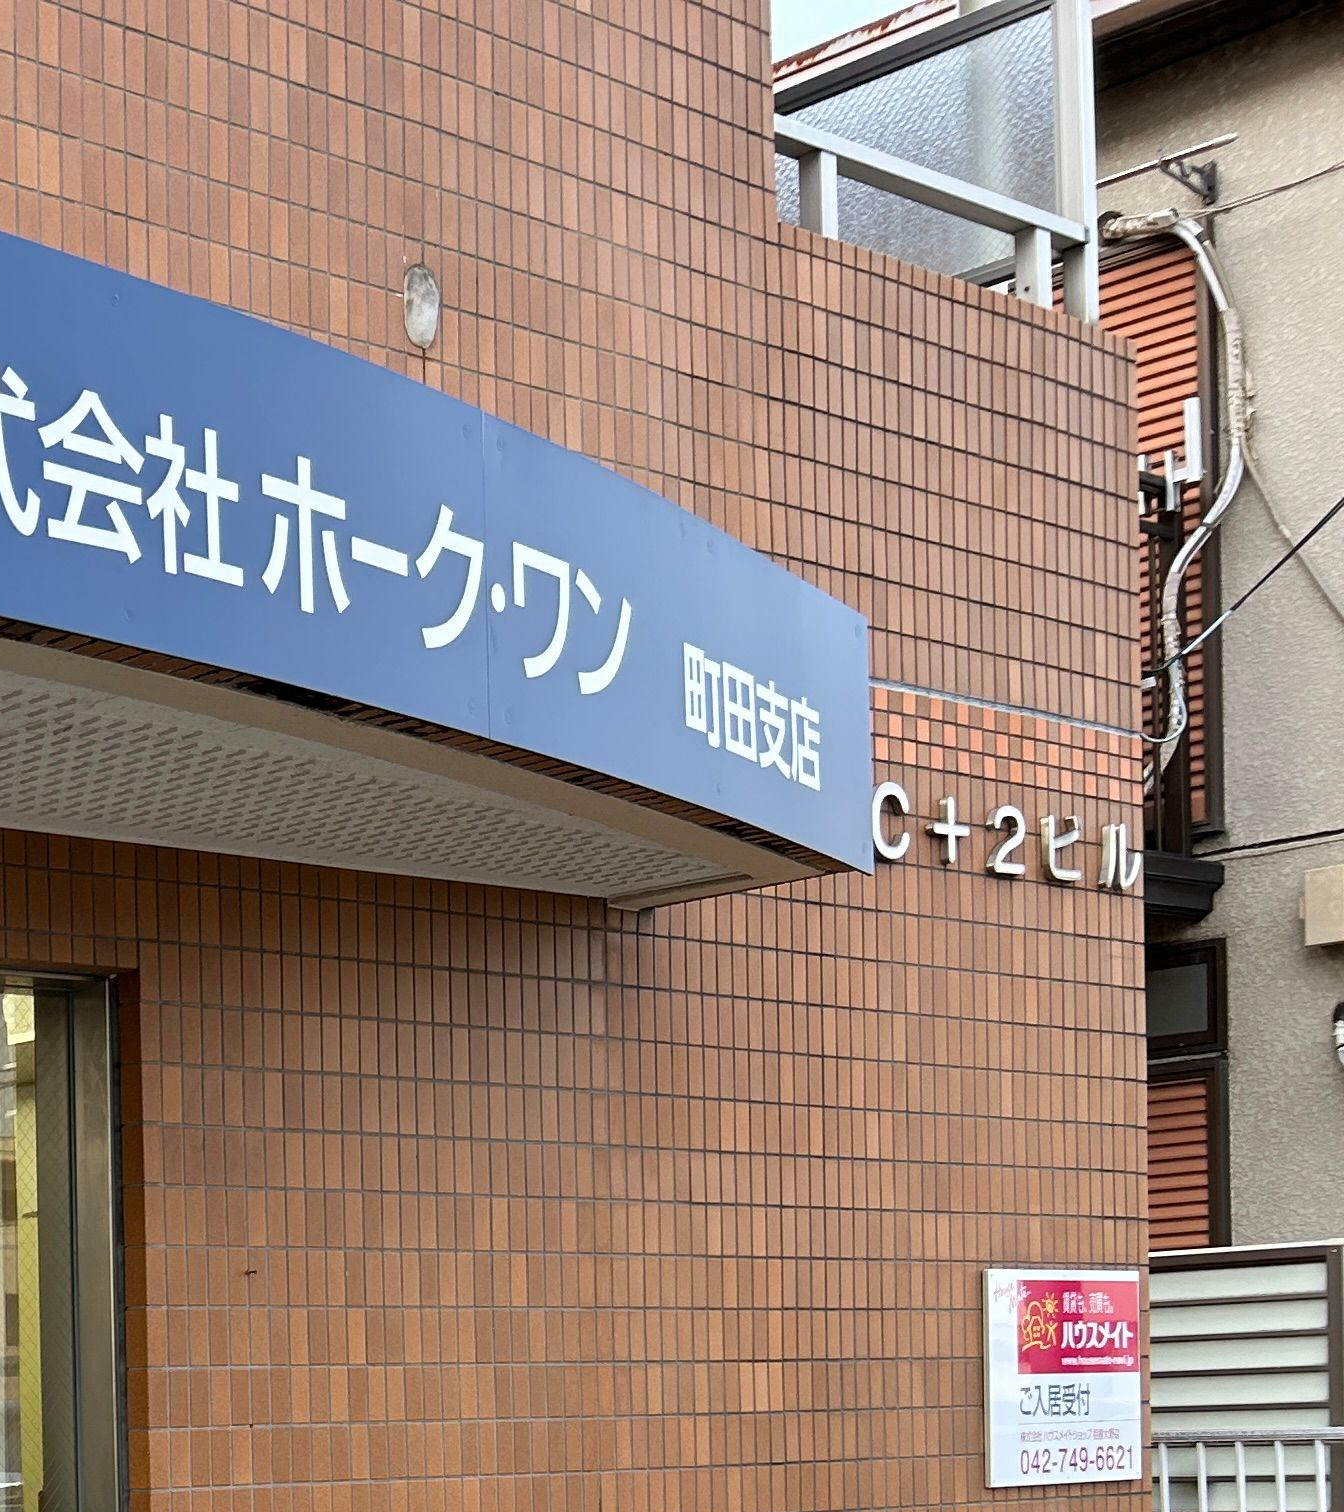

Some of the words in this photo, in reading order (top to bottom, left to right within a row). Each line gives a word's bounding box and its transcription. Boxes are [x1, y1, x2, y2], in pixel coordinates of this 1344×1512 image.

[682, 640, 822, 793] 町田支店
[1060, 1321, 1134, 1349] ハウスメイト
[1019, 1383, 1091, 1417] ご入居受付
[1020, 1444, 1133, 1475] 042-749-6621
